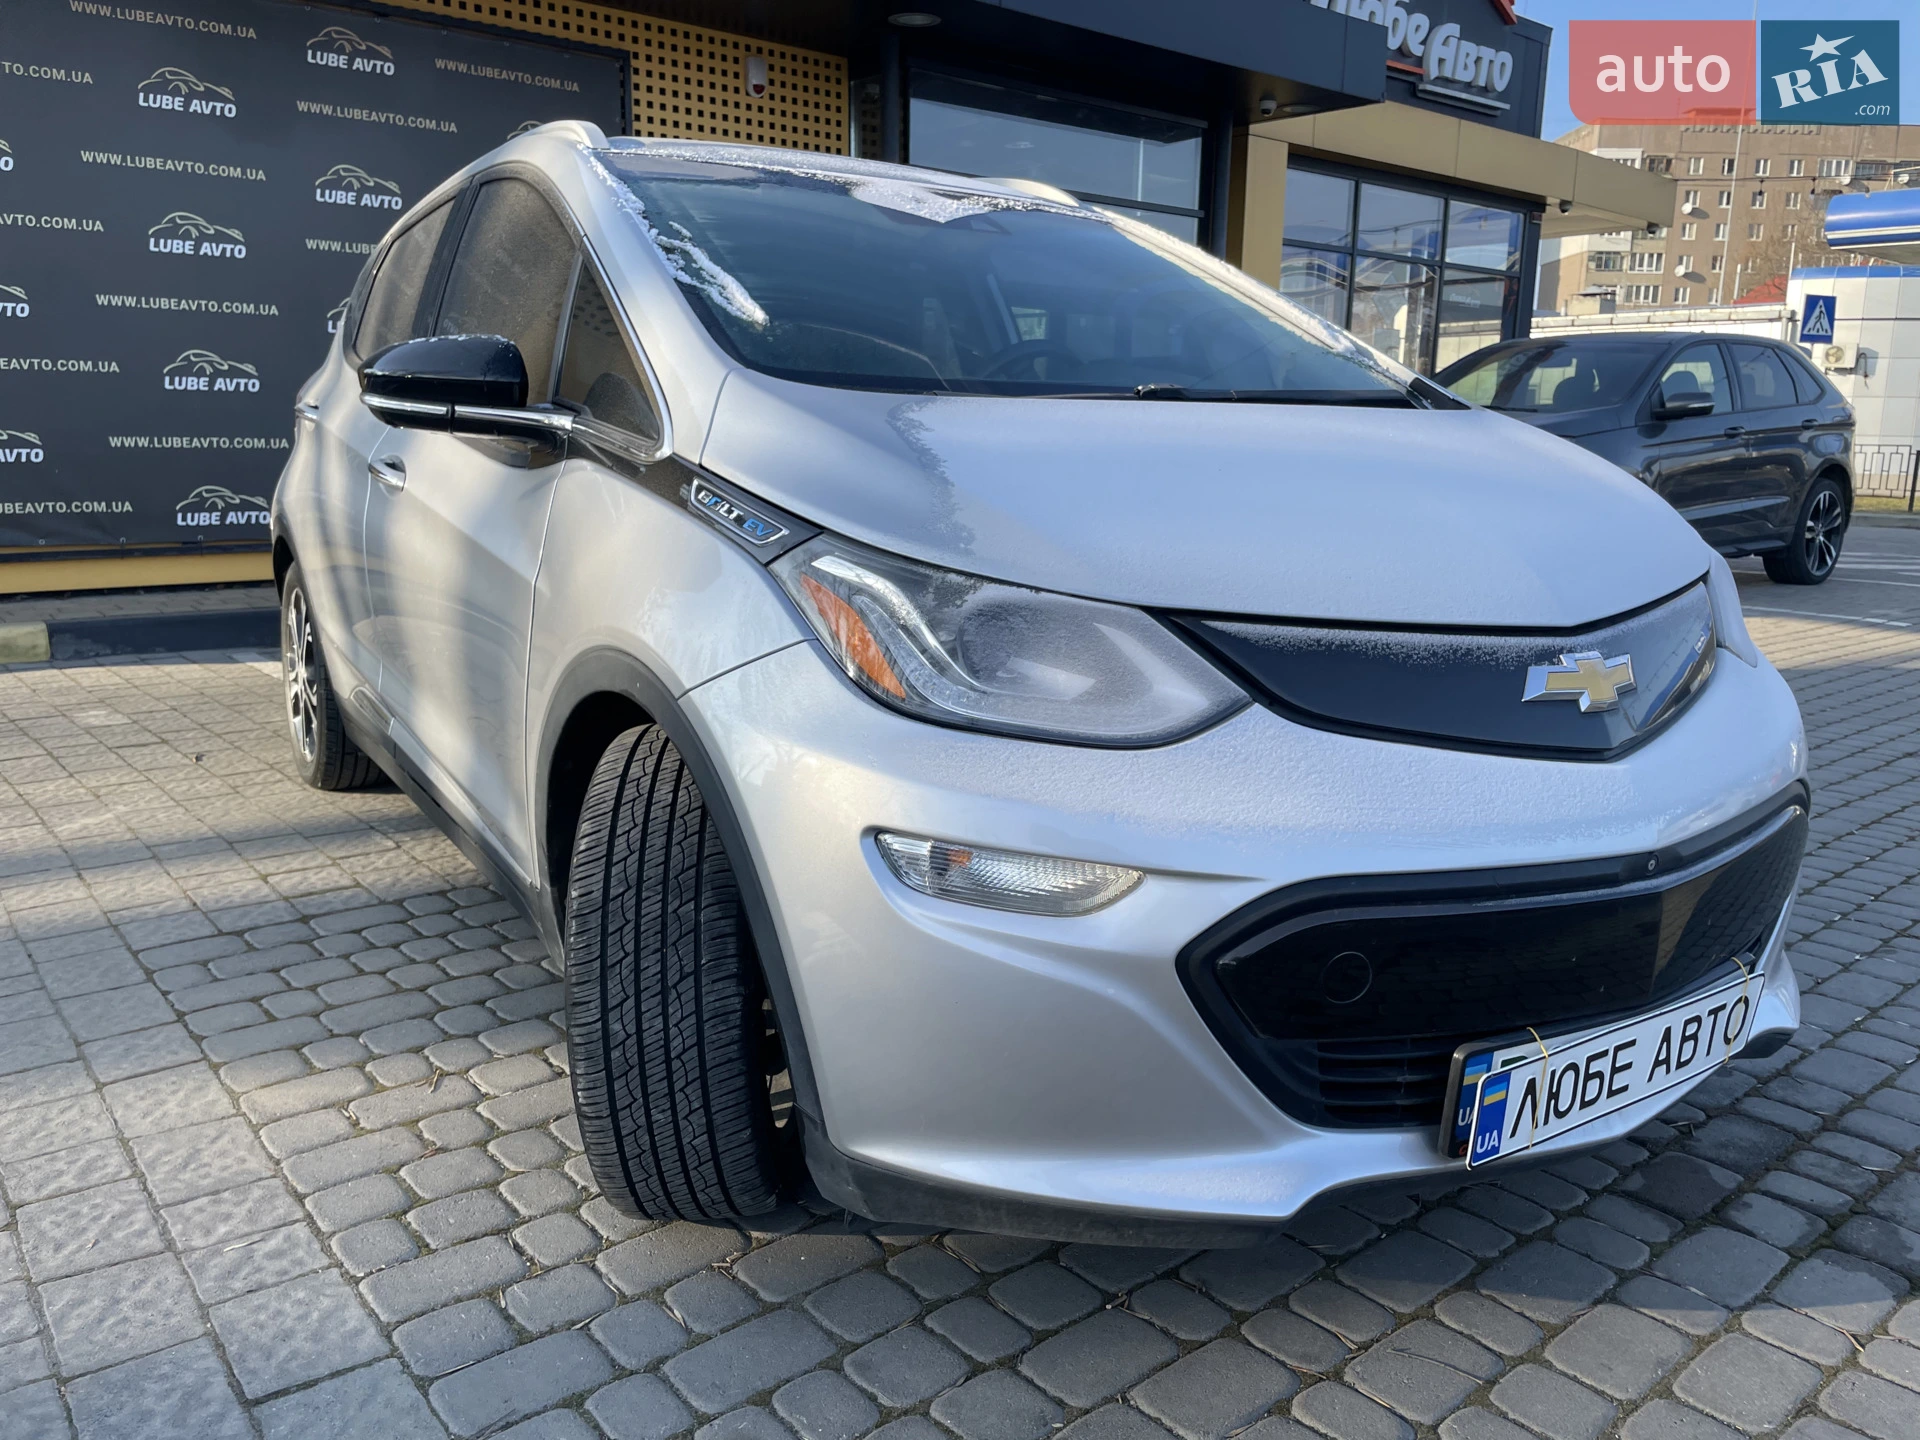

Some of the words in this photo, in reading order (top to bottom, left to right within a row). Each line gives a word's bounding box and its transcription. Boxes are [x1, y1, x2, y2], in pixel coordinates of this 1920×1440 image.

[68, 0, 257, 40] WWW.LUBEAVTO.COM.UA
[306, 49, 349, 70] LUBE
[352, 56, 395, 76] AVTO
[435, 57, 580, 93] WWW.LUBEAVTO.COM.UA
[138, 92, 185, 111] LUBE
[189, 99, 237, 118] AVTO
[296, 100, 458, 134] WWW.LUBEAVTO.COM.UA
[81, 150, 266, 181] WWW.LUBEAVTO.COM.UA
[315, 188, 357, 206] LUBE
[360, 193, 403, 211] AVTO
[149, 237, 195, 255] LUBE
[199, 242, 247, 259] AVTO
[0, 302, 30, 318] TO
[95, 293, 280, 317] WWW.LUBEAVTO.COM.UA
[164, 375, 209, 391] LUBE
[213, 377, 260, 393] AVTO
[109, 435, 290, 450] WWW.LUBEAVTO.COM.UA
[176, 511, 221, 527] LUBE
[225, 510, 271, 526] AVTO
[743, 518, 774, 537] EV
[1509, 1038, 1638, 1139] ЛЮБЕ
[1647, 995, 1750, 1083] АВТО
[1476, 1129, 1499, 1153] UA
